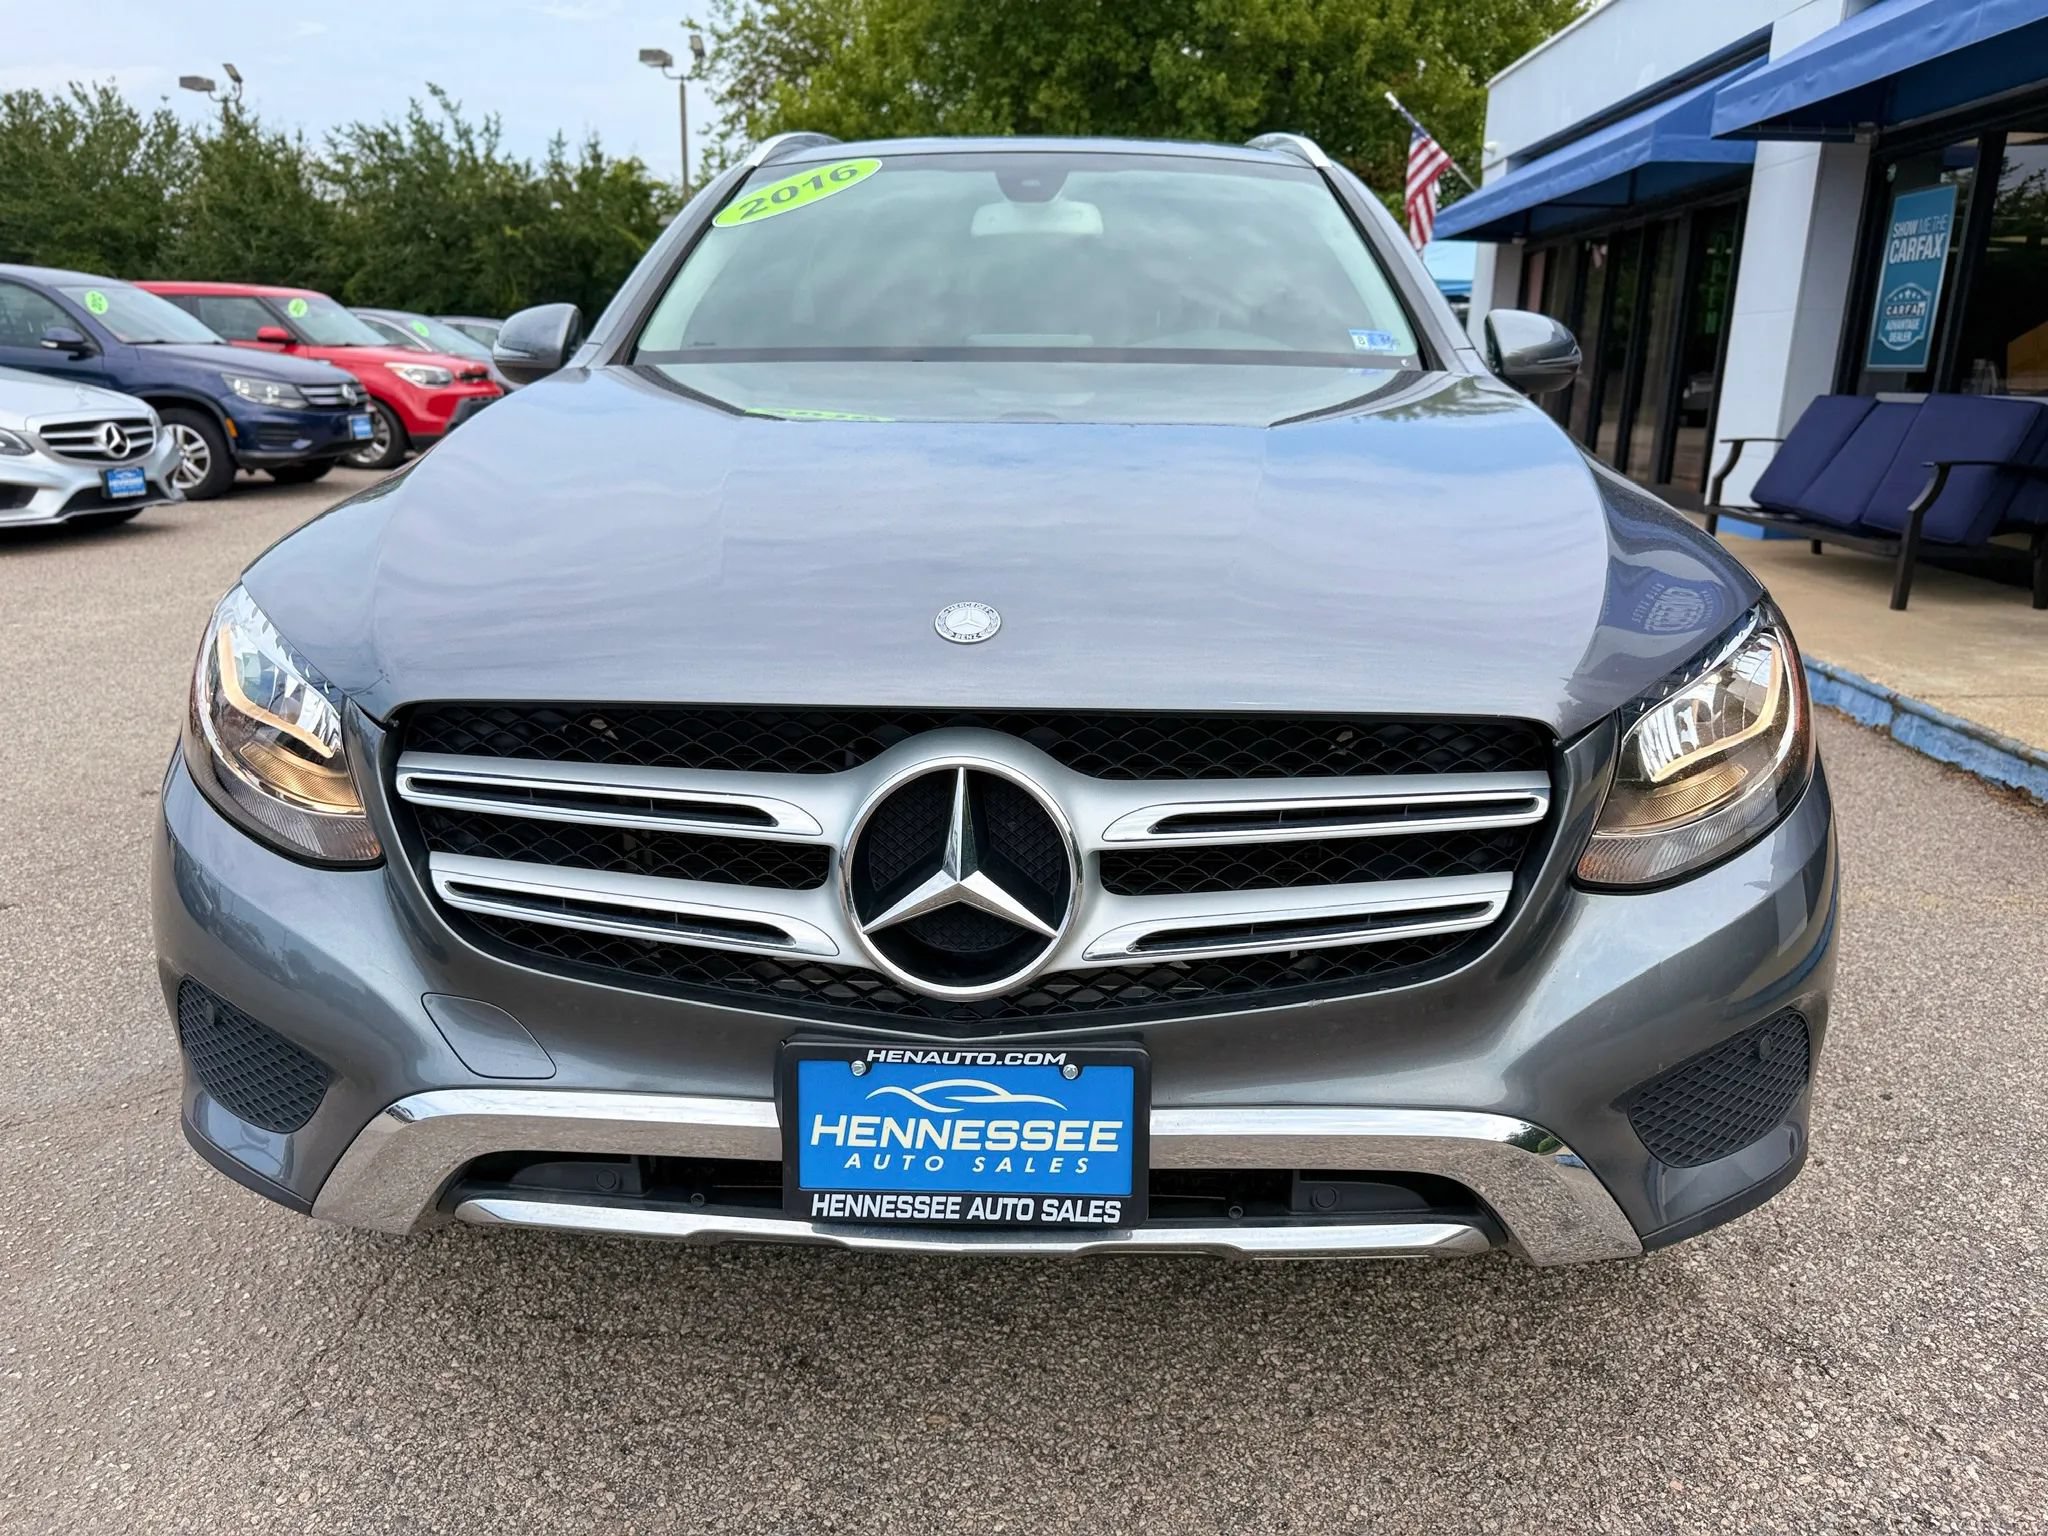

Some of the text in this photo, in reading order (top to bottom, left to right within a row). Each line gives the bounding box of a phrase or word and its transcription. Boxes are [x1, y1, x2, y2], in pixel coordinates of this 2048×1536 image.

[738, 164, 858, 221] 2016
[1892, 219, 1919, 238] SHOW
[1889, 232, 1946, 264] CARFAX
[866, 1049, 1067, 1066] HENAUTO.COM
[810, 1114, 1124, 1152] HENNESSEE
[844, 1153, 1089, 1174] AUTO SALES
[811, 1193, 1122, 1224] HENNESSEE AUTO SALES
